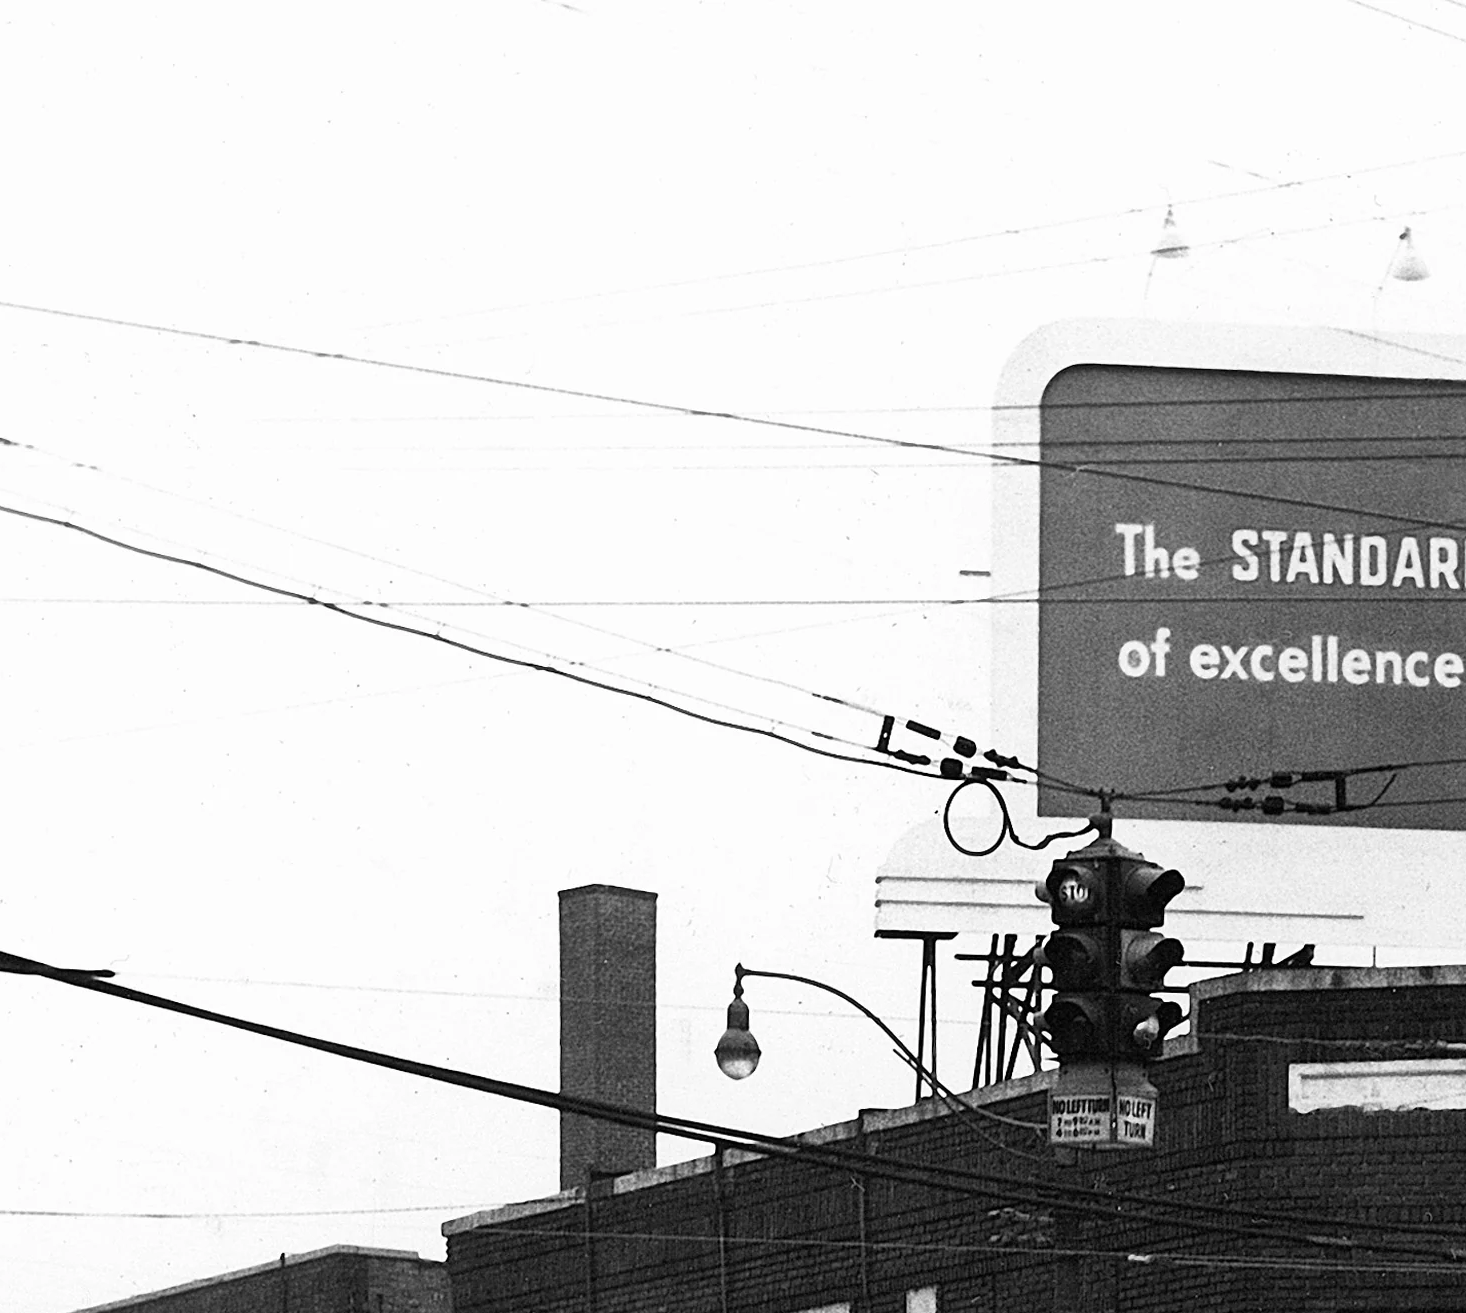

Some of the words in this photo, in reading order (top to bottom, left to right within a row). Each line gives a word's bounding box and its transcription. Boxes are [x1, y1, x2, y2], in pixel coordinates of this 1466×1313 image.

[1115, 523, 1200, 582] The
[1117, 628, 1170, 680] of
[1119, 1099, 1131, 1117] NO
[1132, 1101, 1152, 1120] LEFT
